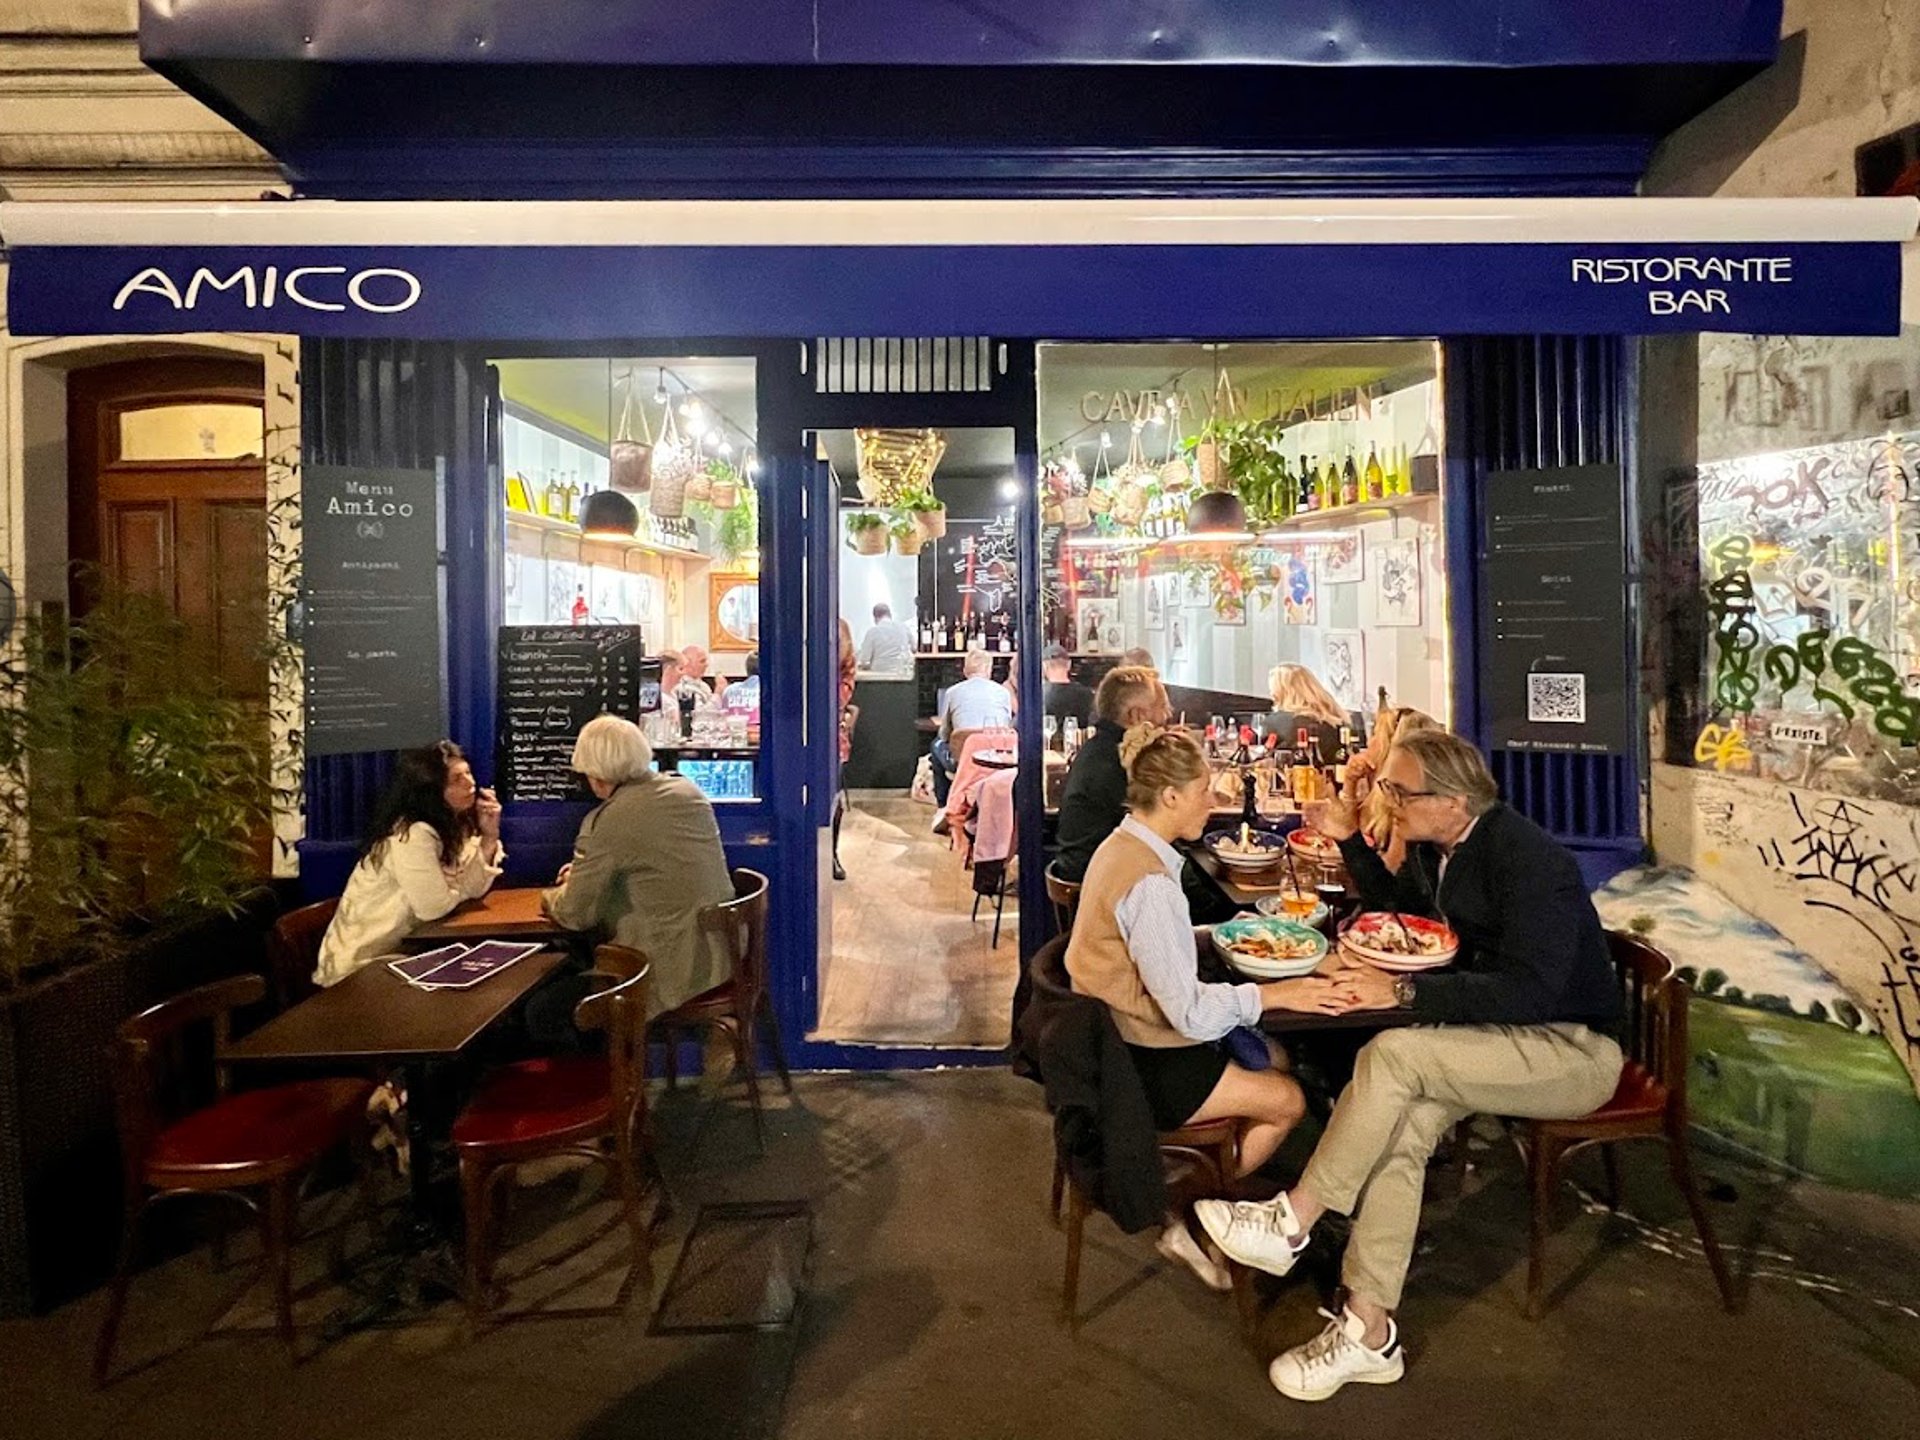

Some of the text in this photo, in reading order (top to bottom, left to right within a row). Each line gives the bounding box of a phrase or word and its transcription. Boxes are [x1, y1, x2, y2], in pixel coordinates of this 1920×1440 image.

[1572, 257, 1793, 283] RISTORANTE
[113, 266, 422, 313] AMICO
[1648, 288, 1731, 315] BAR
[1080, 389, 1161, 422] CAVE
[1264, 385, 1373, 422] ITALIEN
[345, 481, 394, 495] Menu
[326, 496, 414, 517] Amico
